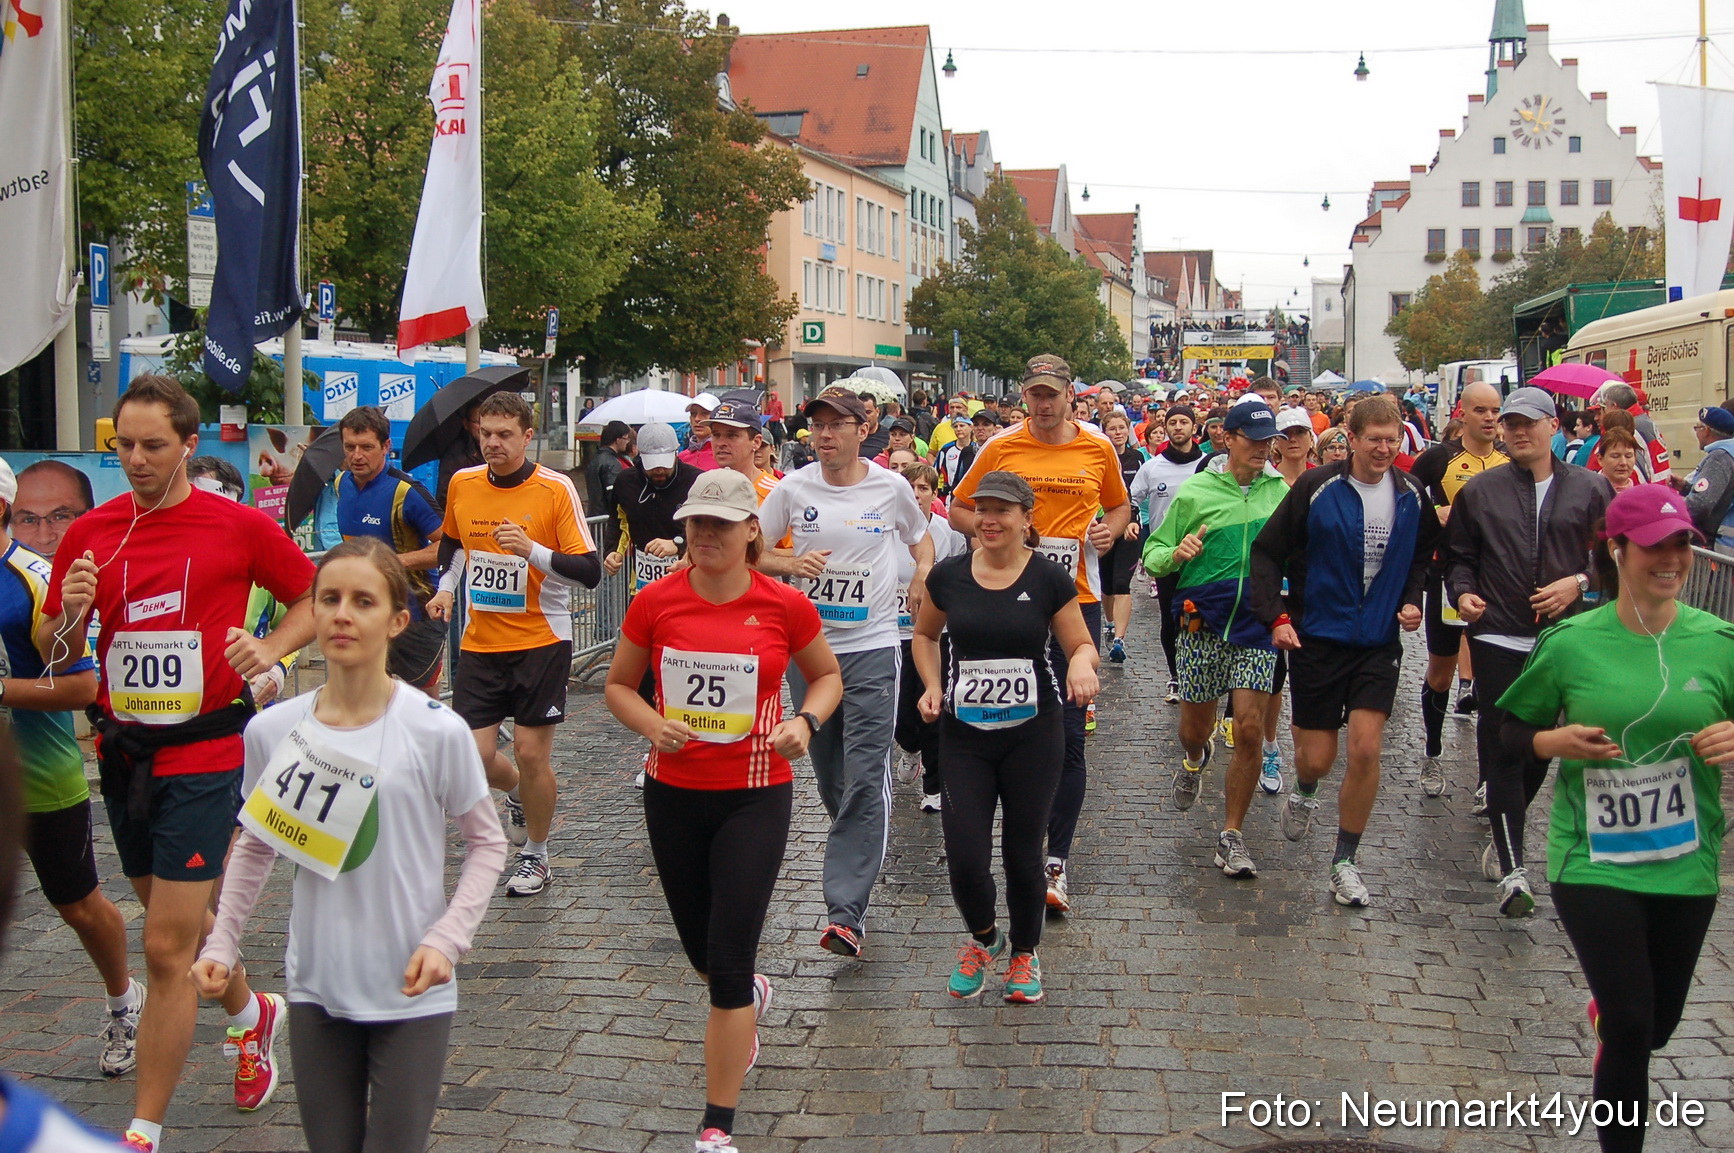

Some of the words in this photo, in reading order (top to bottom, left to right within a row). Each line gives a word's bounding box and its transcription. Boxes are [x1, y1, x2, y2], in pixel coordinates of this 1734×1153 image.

[1212, 349, 1244, 357] START
[1648, 339, 1698, 367] Bayerisches
[1646, 370, 1670, 388] Rotes
[258, 498, 280, 508] BEIDE
[488, 559, 516, 567] Neumarkt
[472, 565, 518, 592] 2981
[826, 568, 859, 576] Neumarkt
[808, 577, 864, 603] 2474
[142, 600, 166, 613] DEHN
[475, 593, 511, 605] Christian
[135, 641, 183, 650] Neumarkt
[123, 654, 182, 688] 209
[662, 656, 690, 669] PARTL
[693, 661, 740, 672] Neumarkt
[984, 667, 1021, 675] Neumarkt
[686, 674, 726, 708] 25
[964, 677, 1029, 704] 2229
[125, 697, 182, 711] Johannes
[683, 714, 726, 730] Bettina
[982, 710, 1010, 720] Birgit
[306, 749, 356, 781] Neumarkt
[1586, 778, 1622, 789] PARTL
[1622, 771, 1672, 788] Neumarkt
[275, 760, 342, 824] 411
[1597, 783, 1686, 829] 3074
[266, 808, 308, 846] Nicole
